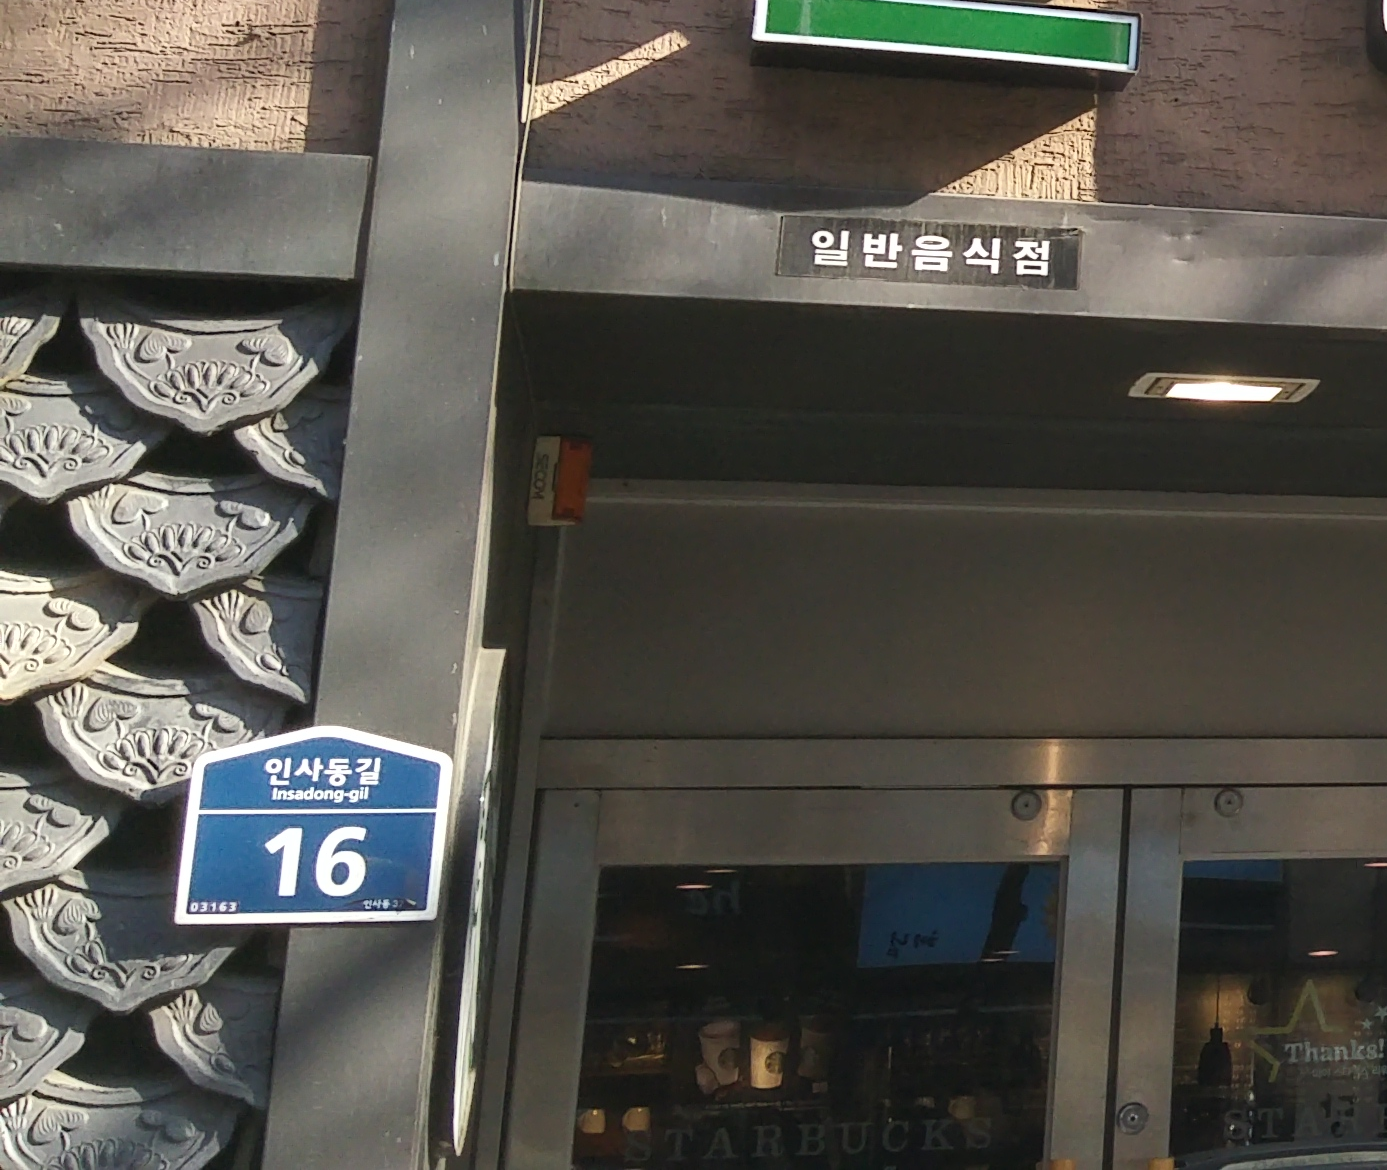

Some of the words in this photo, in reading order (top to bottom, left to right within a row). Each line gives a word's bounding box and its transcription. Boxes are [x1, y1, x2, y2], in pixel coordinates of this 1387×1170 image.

[811, 230, 1050, 276] 일반음식점
[531, 453, 549, 500] SECOM
[264, 756, 382, 787] 인사동길
[271, 786, 369, 803] Insadong-gil
[264, 826, 367, 898] 16
[188, 900, 238, 913] 03163
[362, 898, 391, 910] 인사동
[1283, 1036, 1385, 1065] Thanks!
[622, 1117, 994, 1163] STARBUCKS
